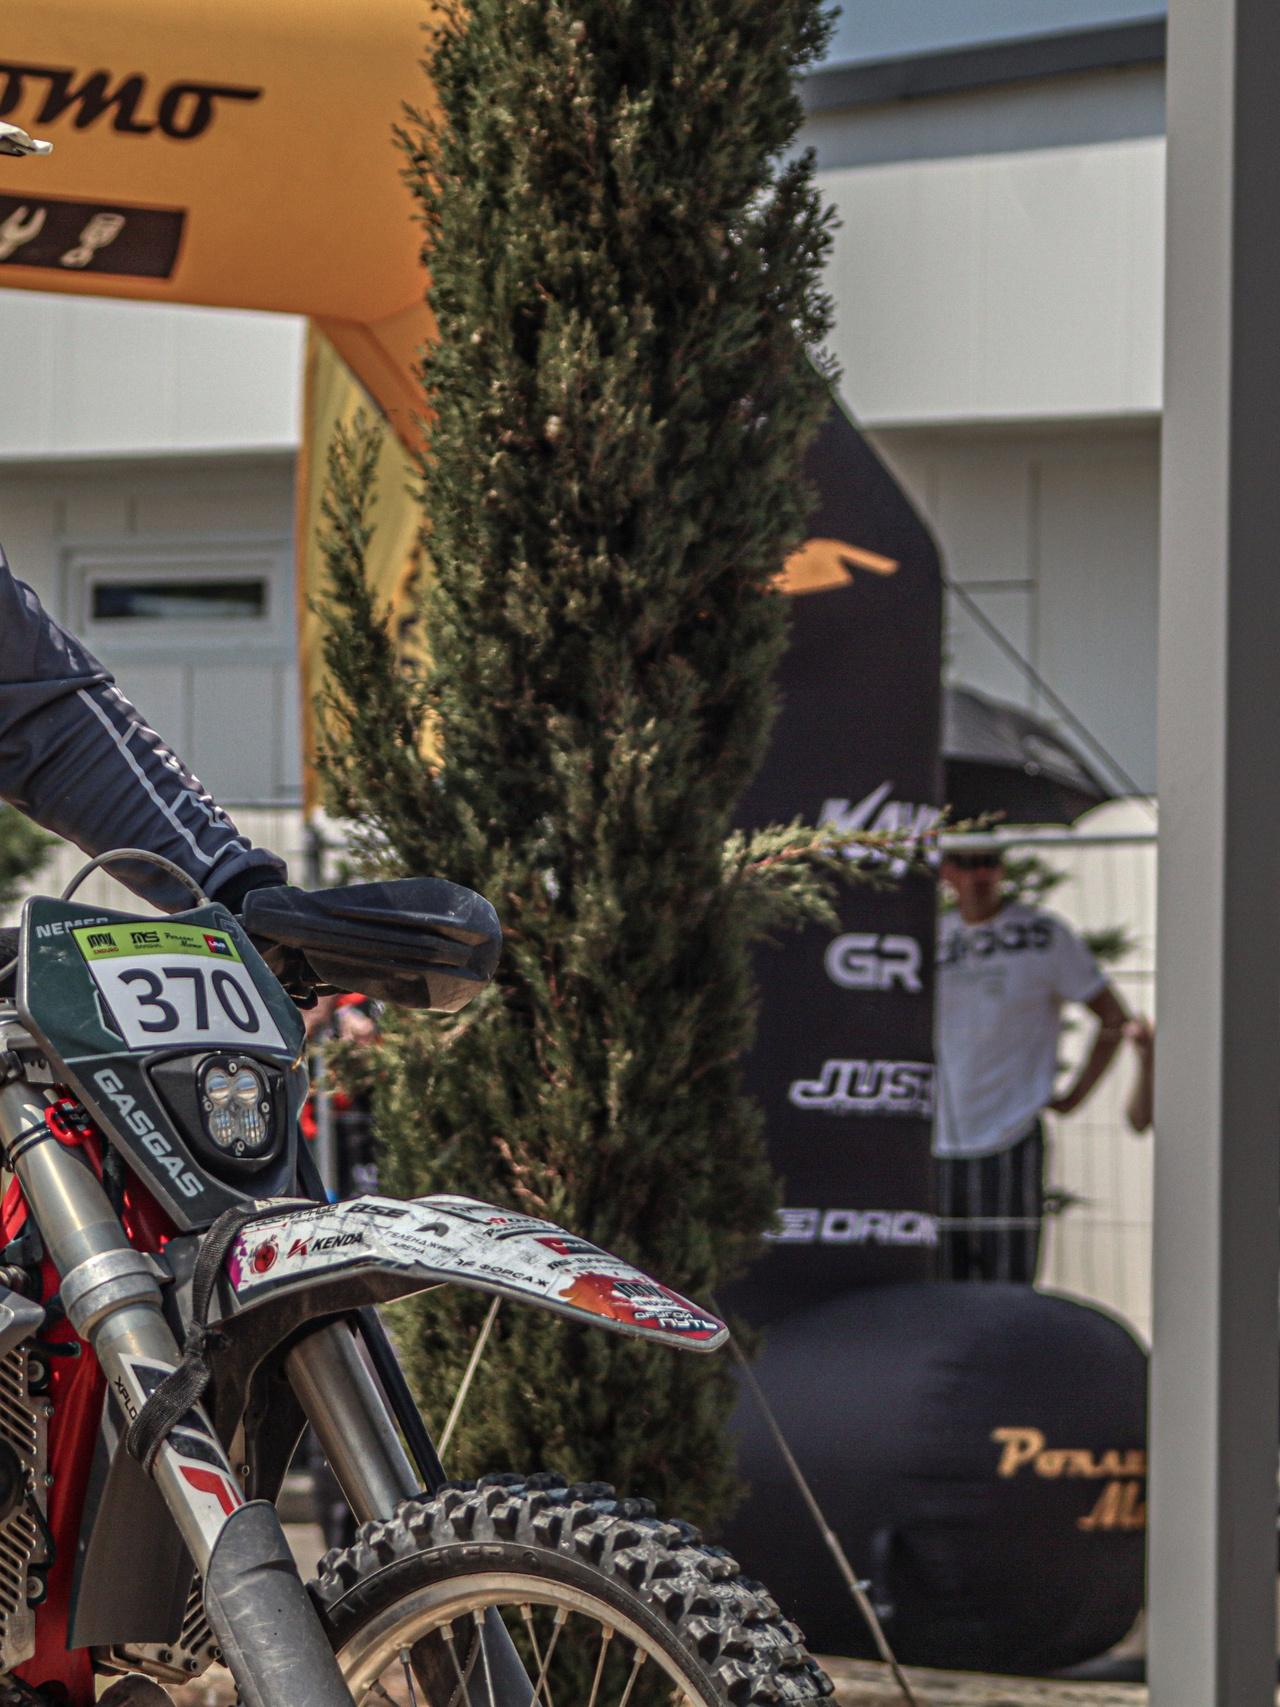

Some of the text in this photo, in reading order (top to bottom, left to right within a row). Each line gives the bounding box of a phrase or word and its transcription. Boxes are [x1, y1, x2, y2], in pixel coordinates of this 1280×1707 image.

[824, 931, 923, 993] GR
[117, 966, 261, 1035] 370
[93, 1068, 206, 1198] GASGAS
[311, 1231, 365, 1252] KENDA
[390, 1242, 426, 1255] АРЕНА
[479, 1263, 551, 1288] ФОРСАЖ
[658, 1317, 719, 1330] ПУТЬ
